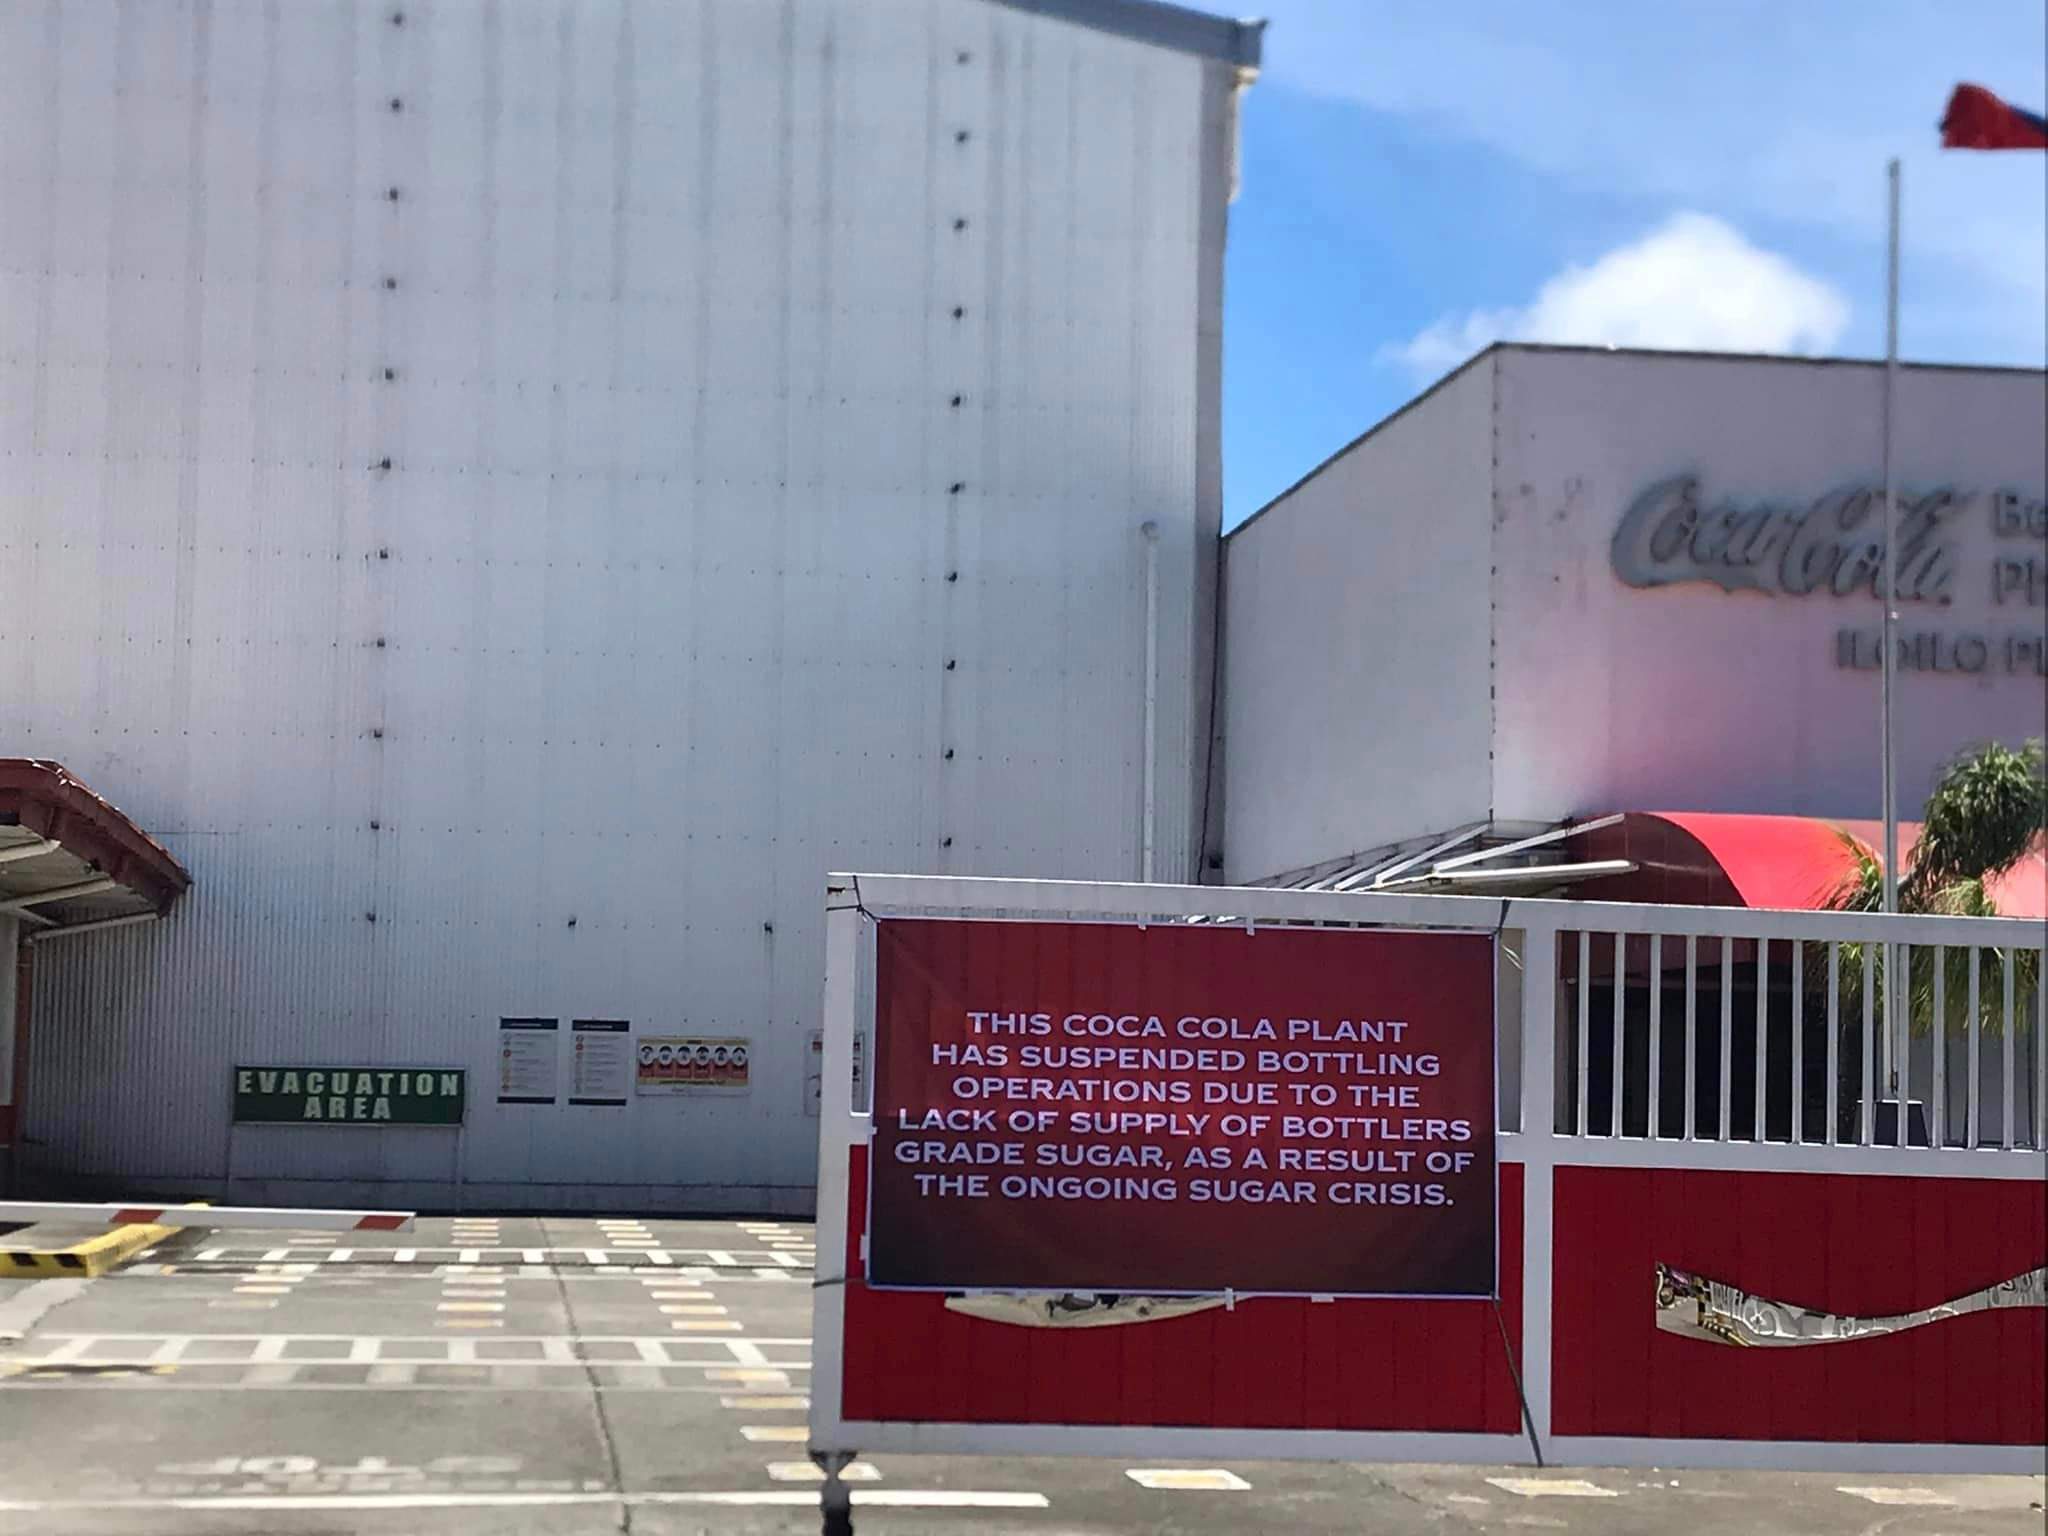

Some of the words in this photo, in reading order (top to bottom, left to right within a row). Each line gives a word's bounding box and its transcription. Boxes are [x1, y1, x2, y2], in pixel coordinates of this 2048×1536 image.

[967, 1013, 1051, 1035] THIS
[1064, 1015, 1166, 1037] COCA
[1177, 1017, 1276, 1039] COLA
[1289, 1020, 1408, 1042] PLANT
[933, 1044, 1008, 1065] HAS
[1020, 1046, 1245, 1071] SUSPENDED
[1258, 1051, 1439, 1075] BOTTLING
[238, 1071, 459, 1096] EVACUATION
[953, 1077, 1191, 1102] OPERATIONS
[1204, 1082, 1278, 1104] DUE
[1288, 1084, 1337, 1105] TO
[1348, 1086, 1419, 1107] THE
[304, 1096, 392, 1119] AREA
[900, 1108, 996, 1131] LACK
[1009, 1111, 1059, 1132] OF
[1070, 1112, 1210, 1135] SUPPLY
[1221, 1115, 1270, 1136] OF
[1283, 1116, 1471, 1141] BOTTLERS
[895, 1141, 1024, 1164] GRADE
[1037, 1144, 1172, 1171] SUGAR,
[1184, 1147, 1231, 1168] AS
[1243, 1148, 1268, 1169] A
[1280, 1149, 1415, 1172] RESULT
[1426, 1152, 1474, 1173] OF
[914, 1174, 989, 1197] THE
[1001, 1176, 1176, 1200] ONGOING
[1190, 1180, 1316, 1203] SUGAR
[1329, 1183, 1453, 1205] CRISIS.
